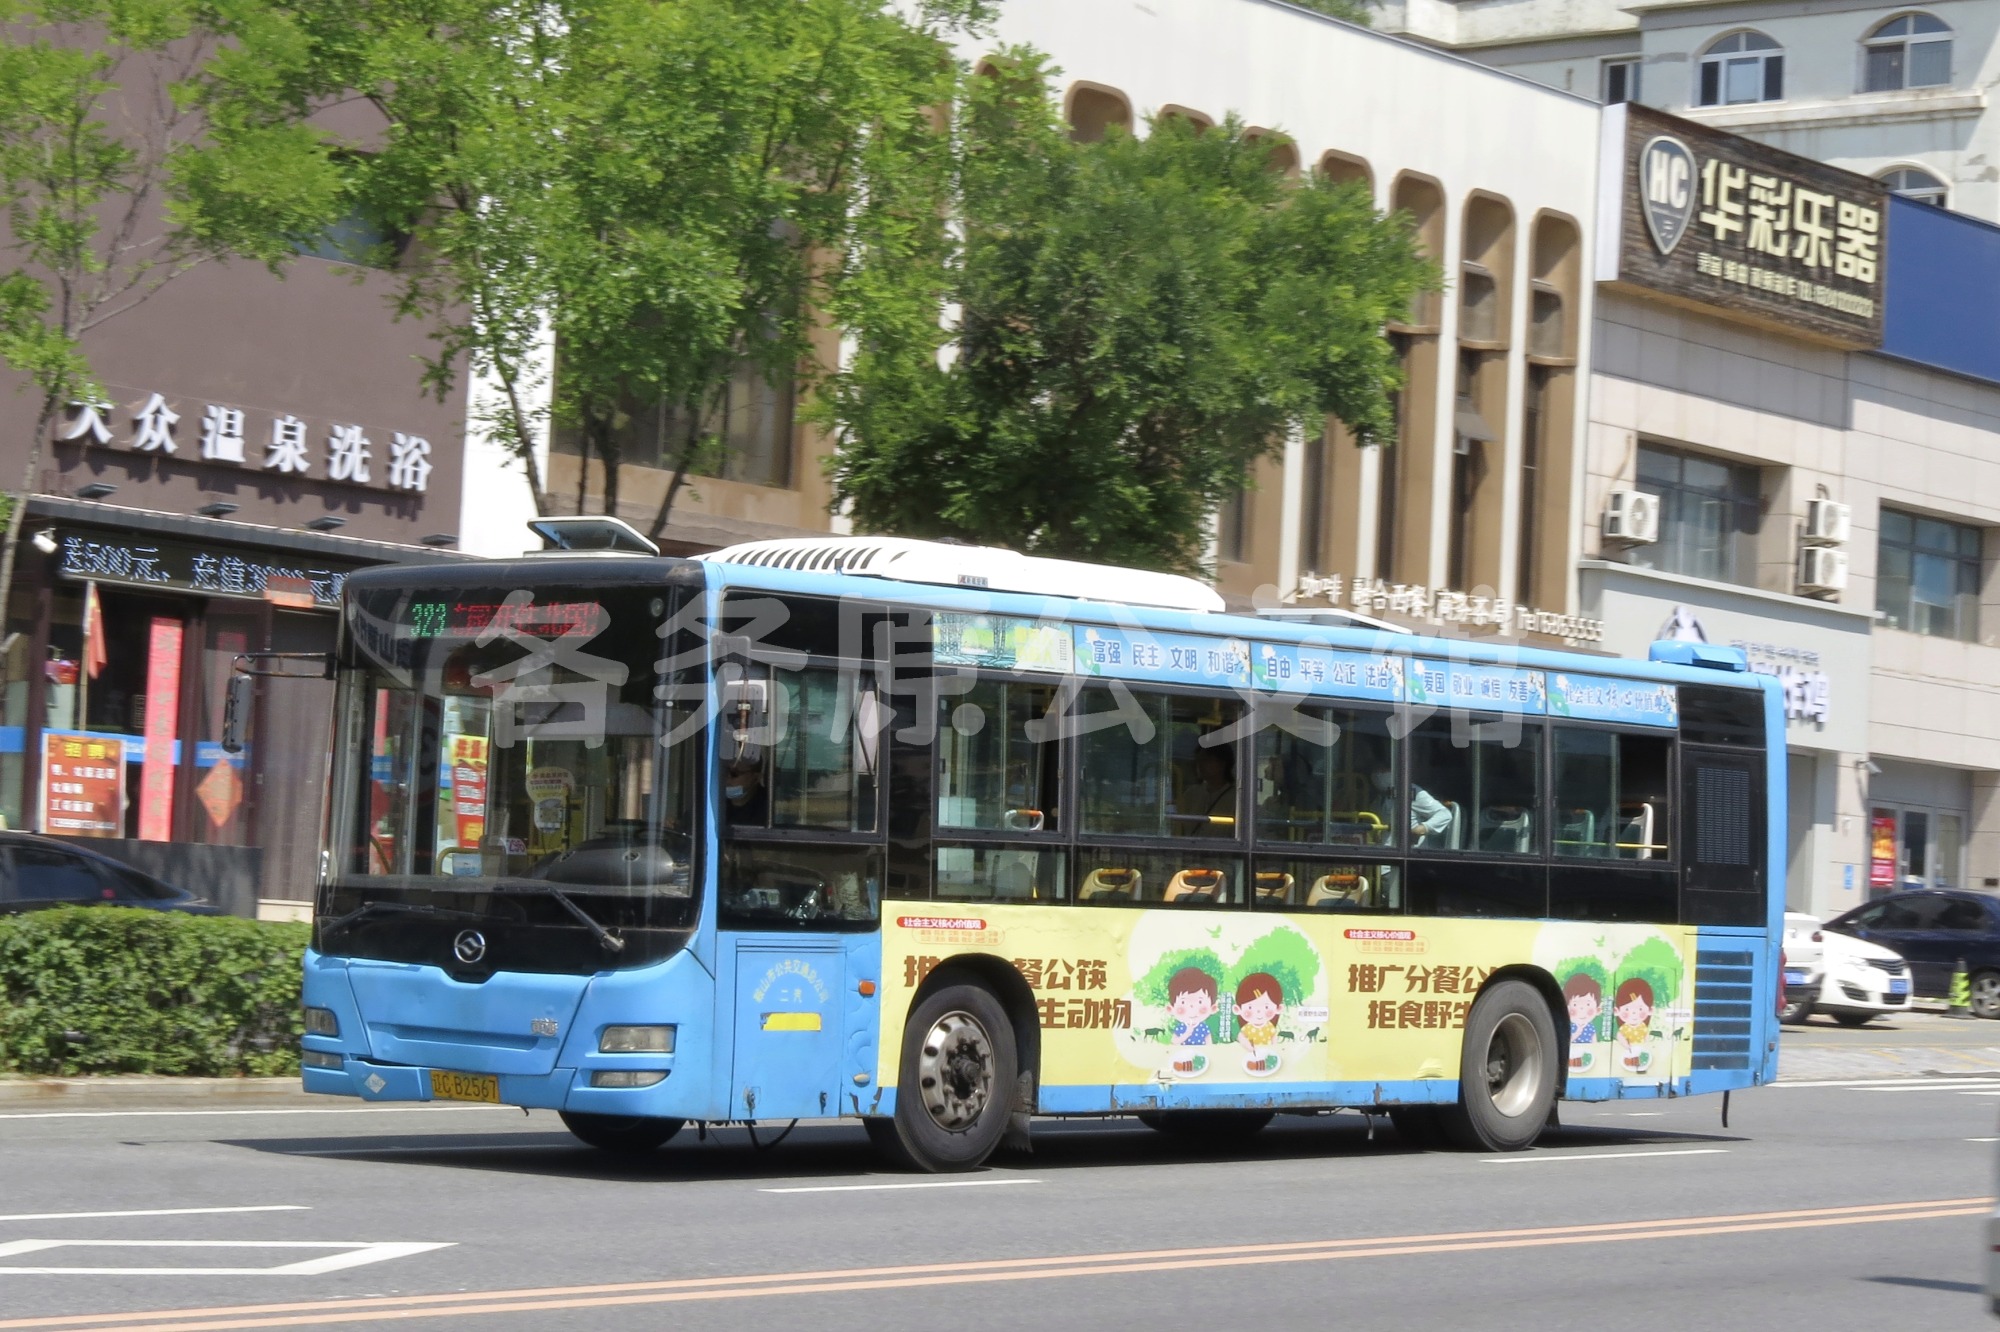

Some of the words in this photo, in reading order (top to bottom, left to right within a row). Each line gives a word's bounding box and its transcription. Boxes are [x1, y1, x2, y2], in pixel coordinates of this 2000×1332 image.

[1649, 149, 1689, 209] HC
[1699, 158, 1880, 284] 华彩乐器
[64, 392, 434, 492] 大众温泉洗浴
[1300, 571, 1343, 604] 咖啡
[410, 603, 447, 637] 323
[1092, 640, 1121, 665] 富强
[1132, 644, 1160, 668] 民主
[1170, 647, 1198, 671] 文明
[1208, 650, 1234, 675] 和谐
[1267, 655, 1291, 679] 自由
[1300, 658, 1324, 683] 平等
[1333, 661, 1356, 685] 公正
[1365, 664, 1388, 688] 法治
[1423, 671, 1445, 693] 爱国
[1453, 674, 1473, 696] 敬业
[1480, 677, 1501, 698] 诚信
[1508, 679, 1528, 701] 友善
[903, 917, 982, 929] 社会主义核心价值观
[1348, 963, 1497, 993] 推广分餐公
